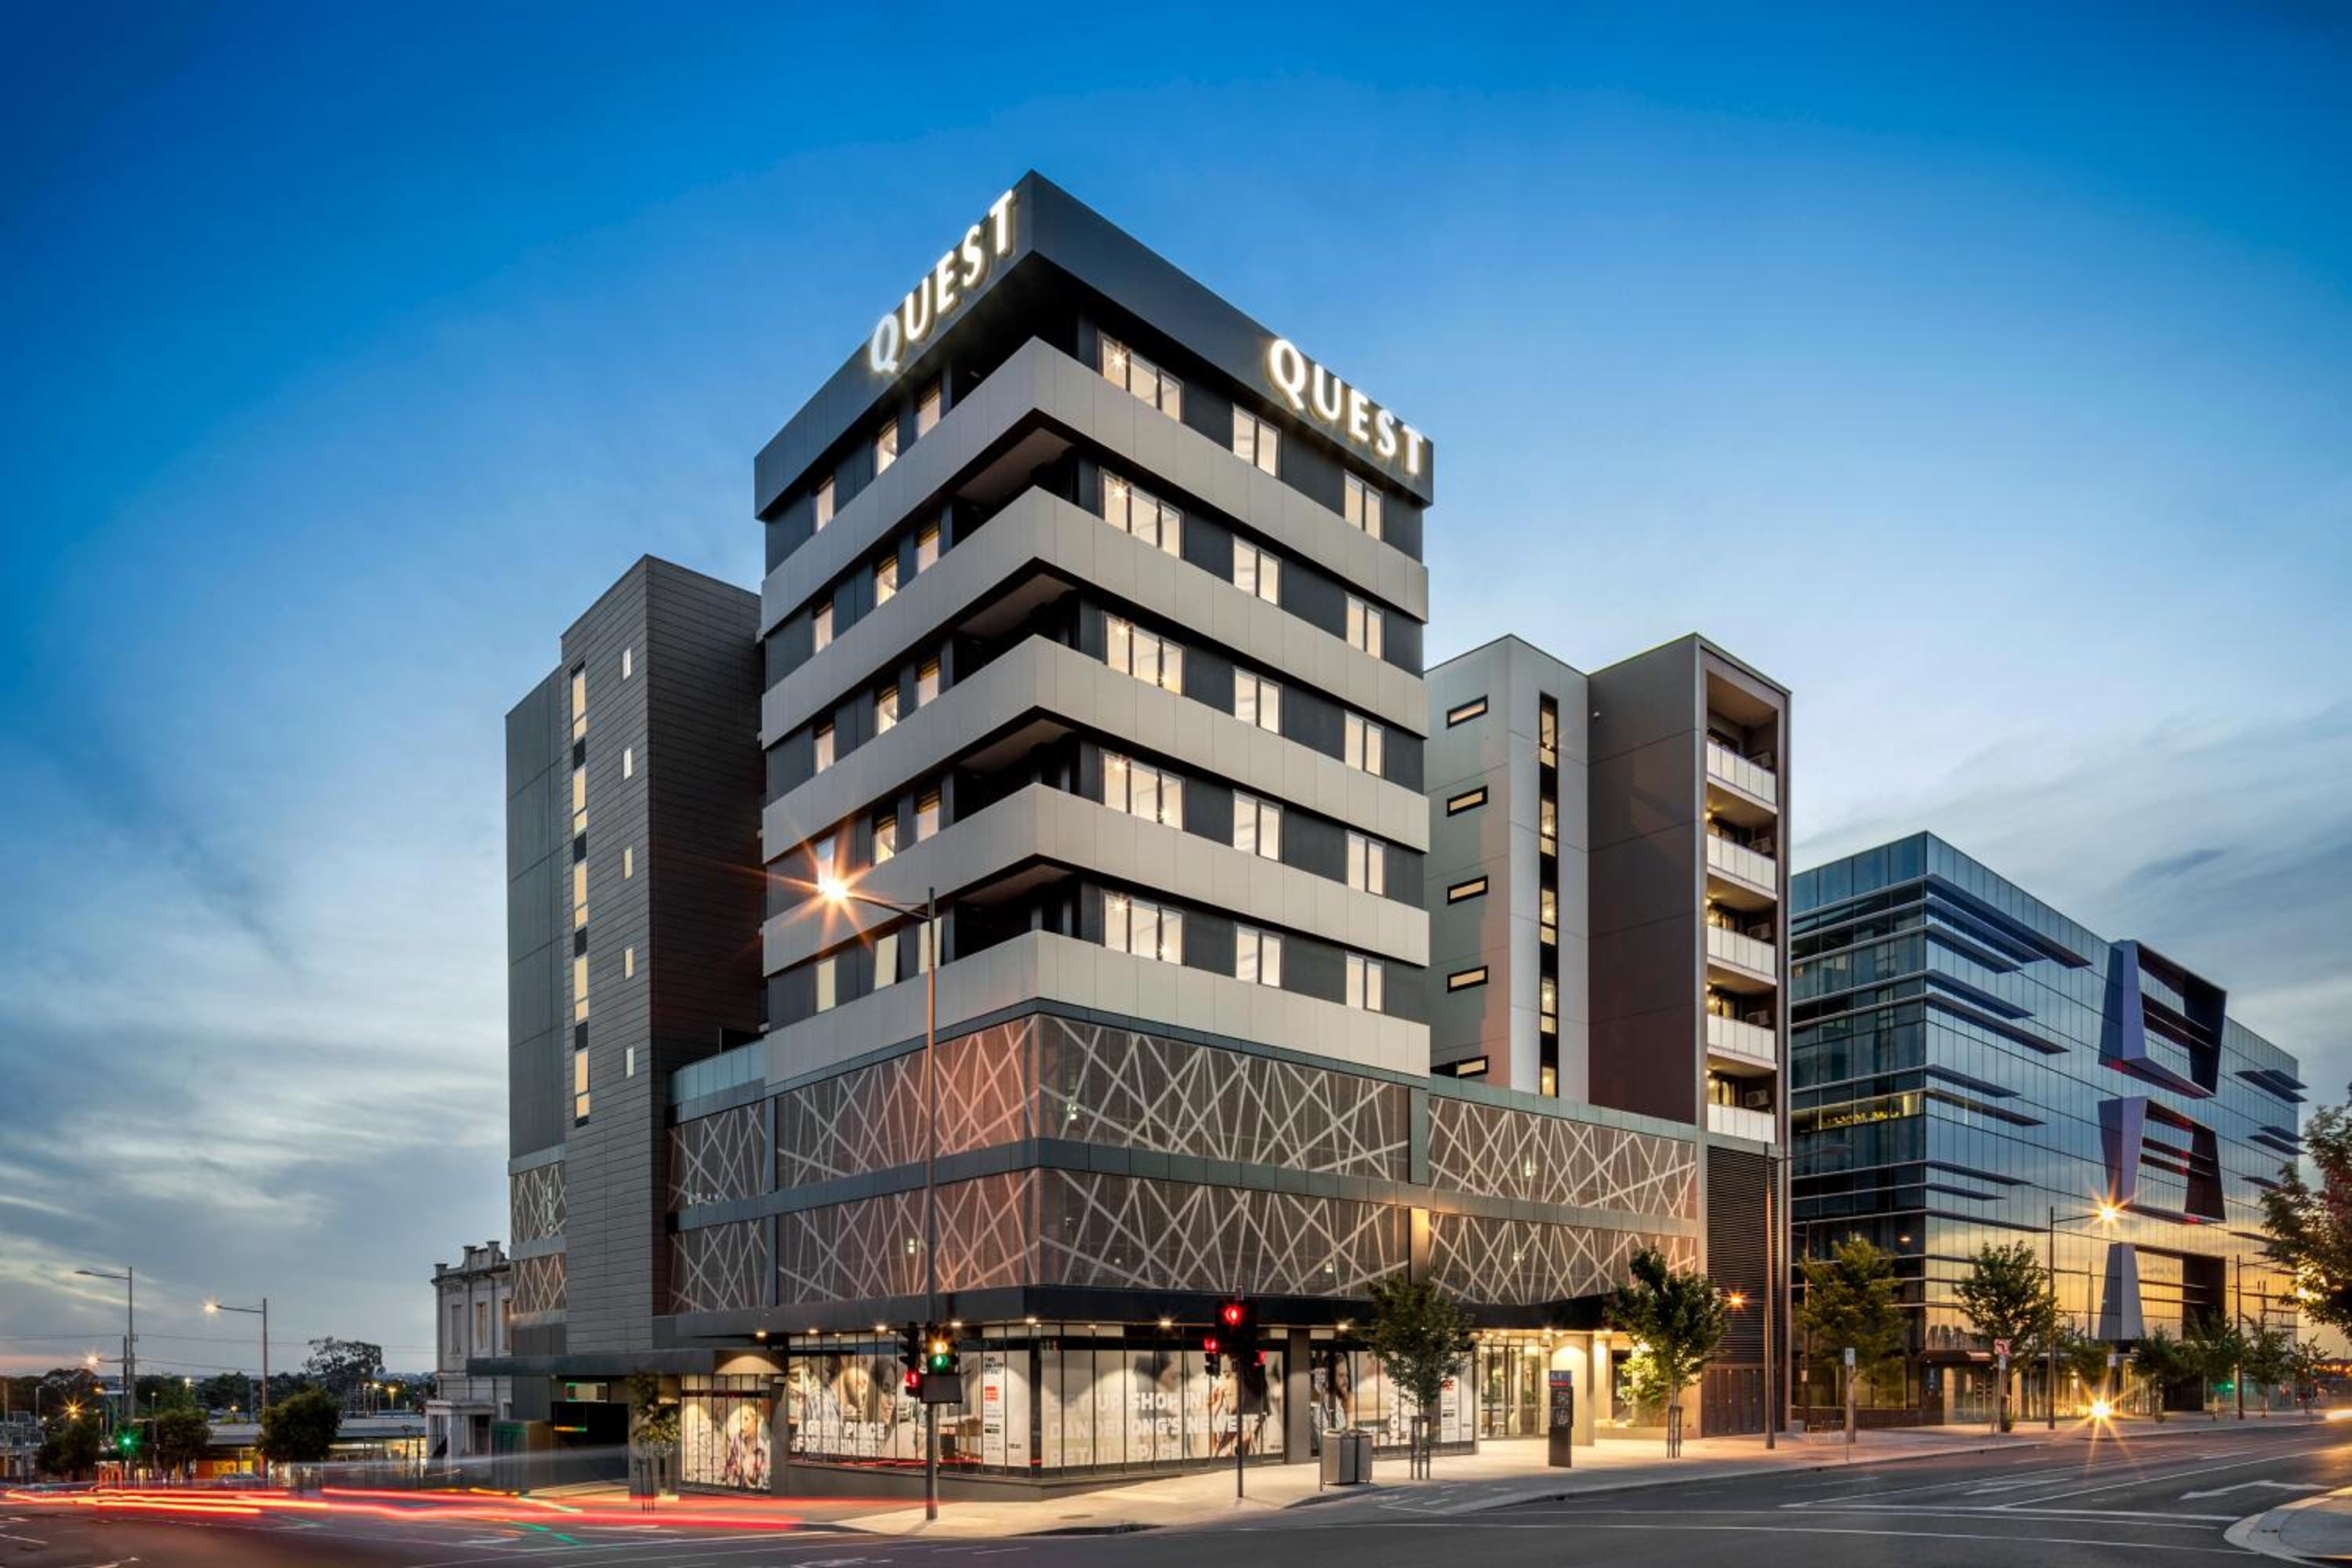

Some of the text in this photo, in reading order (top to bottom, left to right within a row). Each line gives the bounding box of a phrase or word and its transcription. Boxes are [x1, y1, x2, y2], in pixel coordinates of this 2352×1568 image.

[870, 189, 1013, 373] QUEST
[1270, 339, 1424, 474] QUEST
[1097, 1393, 1124, 1411] UP
[1127, 1392, 1180, 1410] SHOP
[1185, 1392, 1201, 1409] IN
[1127, 1443, 1181, 1461] SPACE
